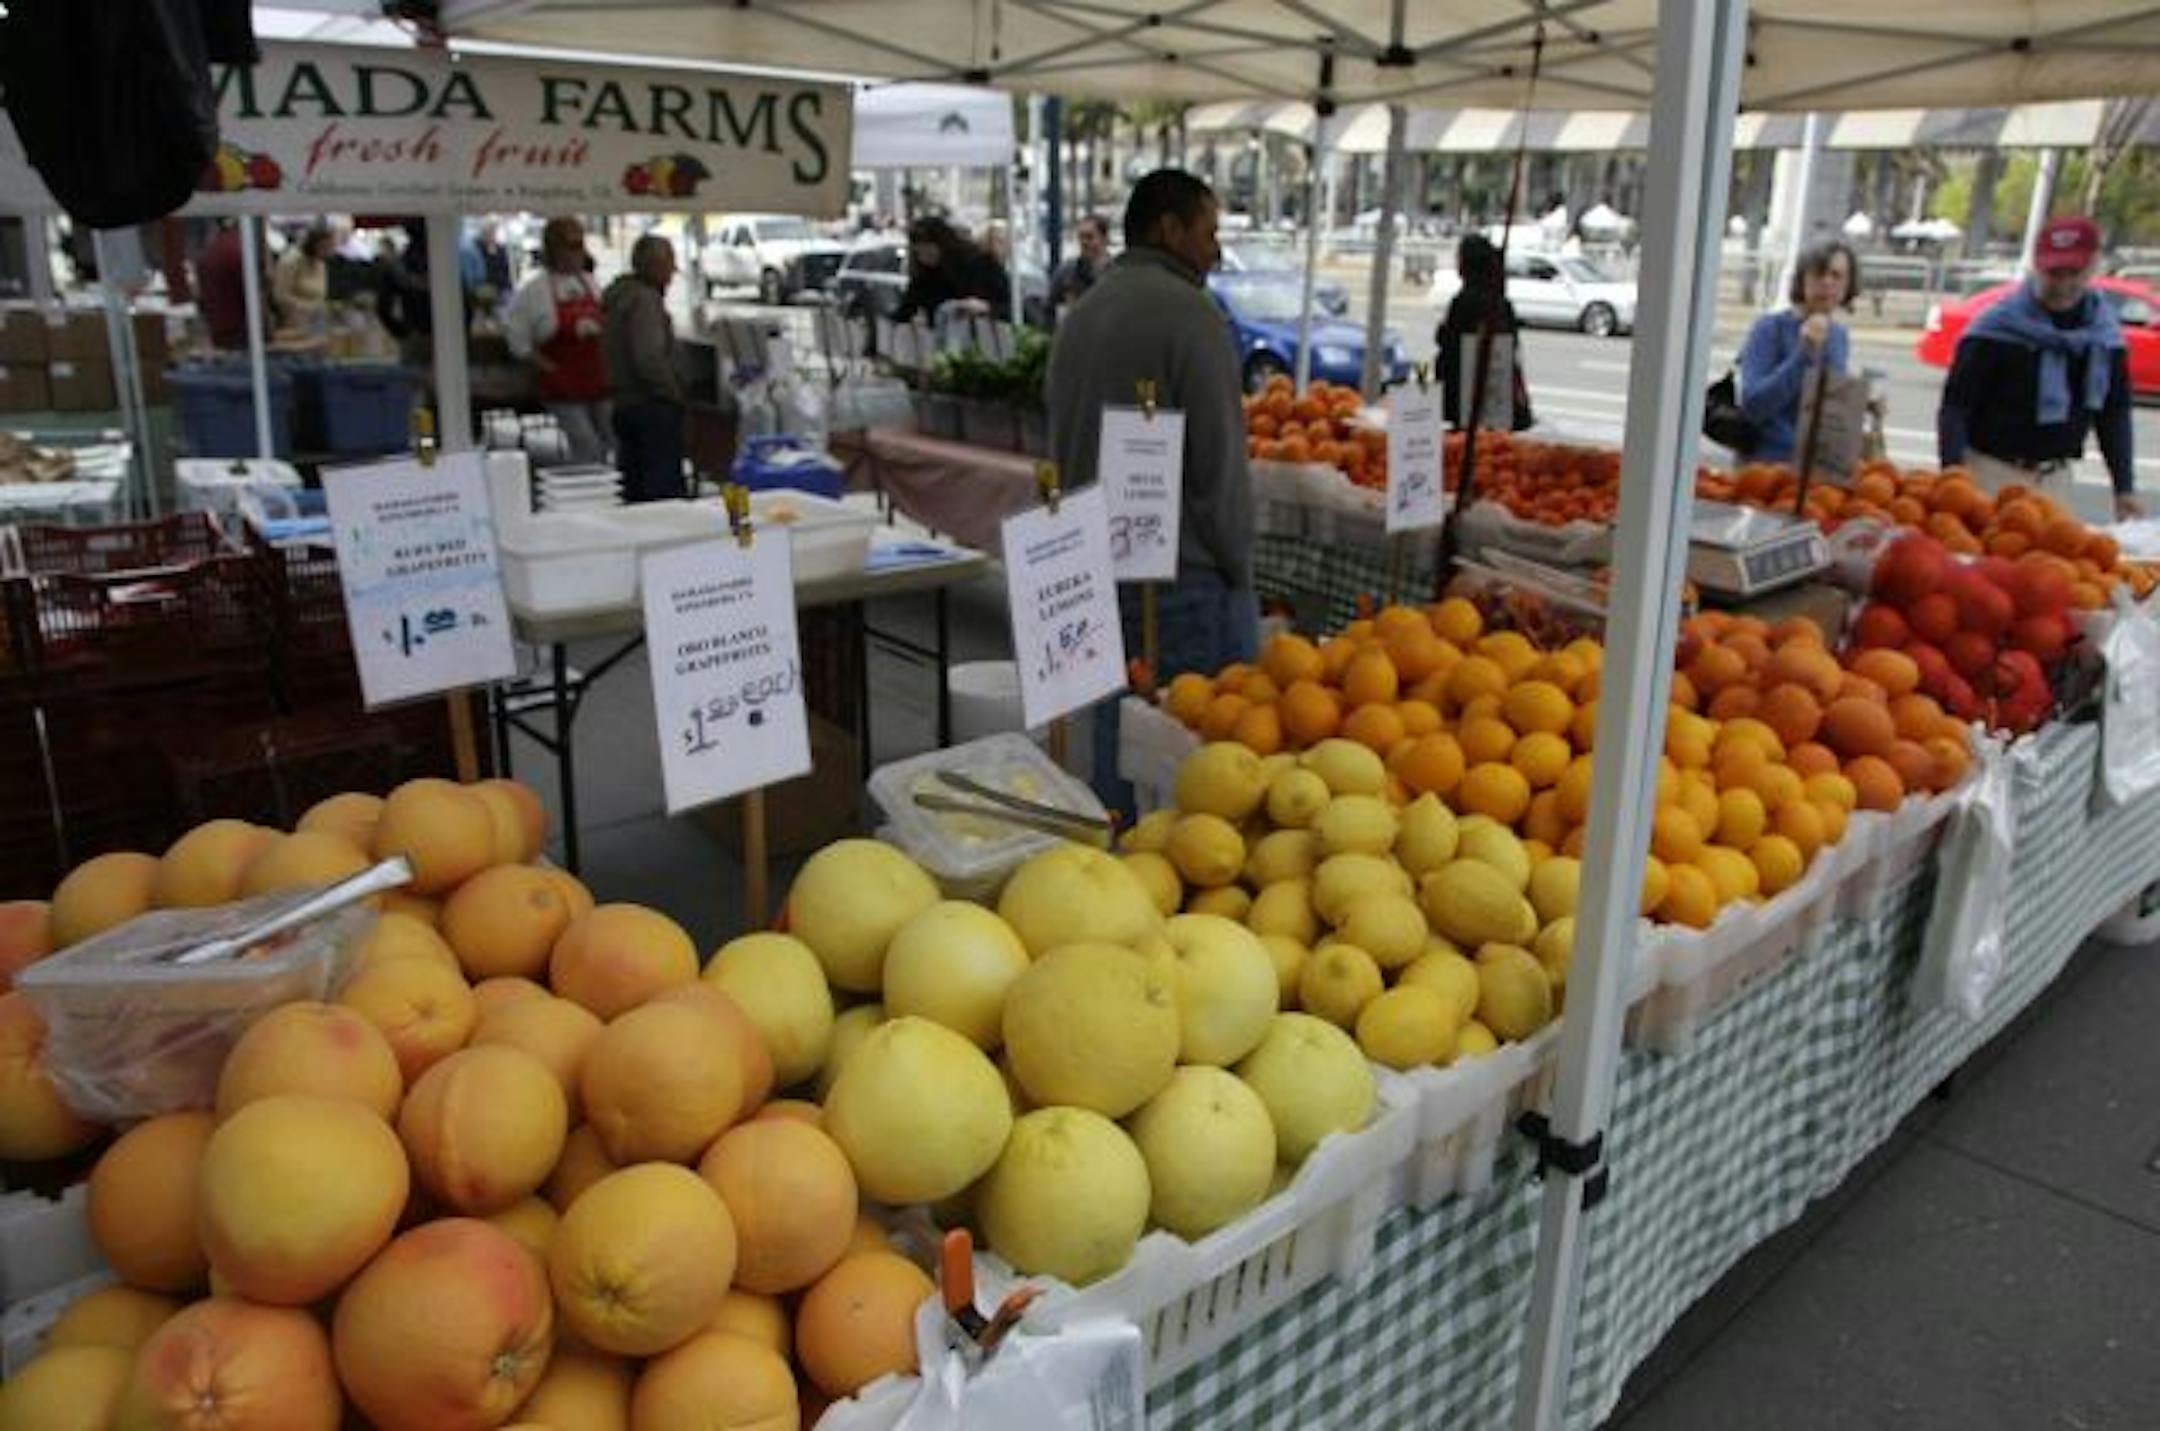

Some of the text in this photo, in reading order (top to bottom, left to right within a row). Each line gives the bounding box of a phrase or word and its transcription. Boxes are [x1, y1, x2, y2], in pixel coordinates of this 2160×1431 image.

[305, 121, 590, 180] fresh fruit
[539, 76, 829, 185] FARMS
